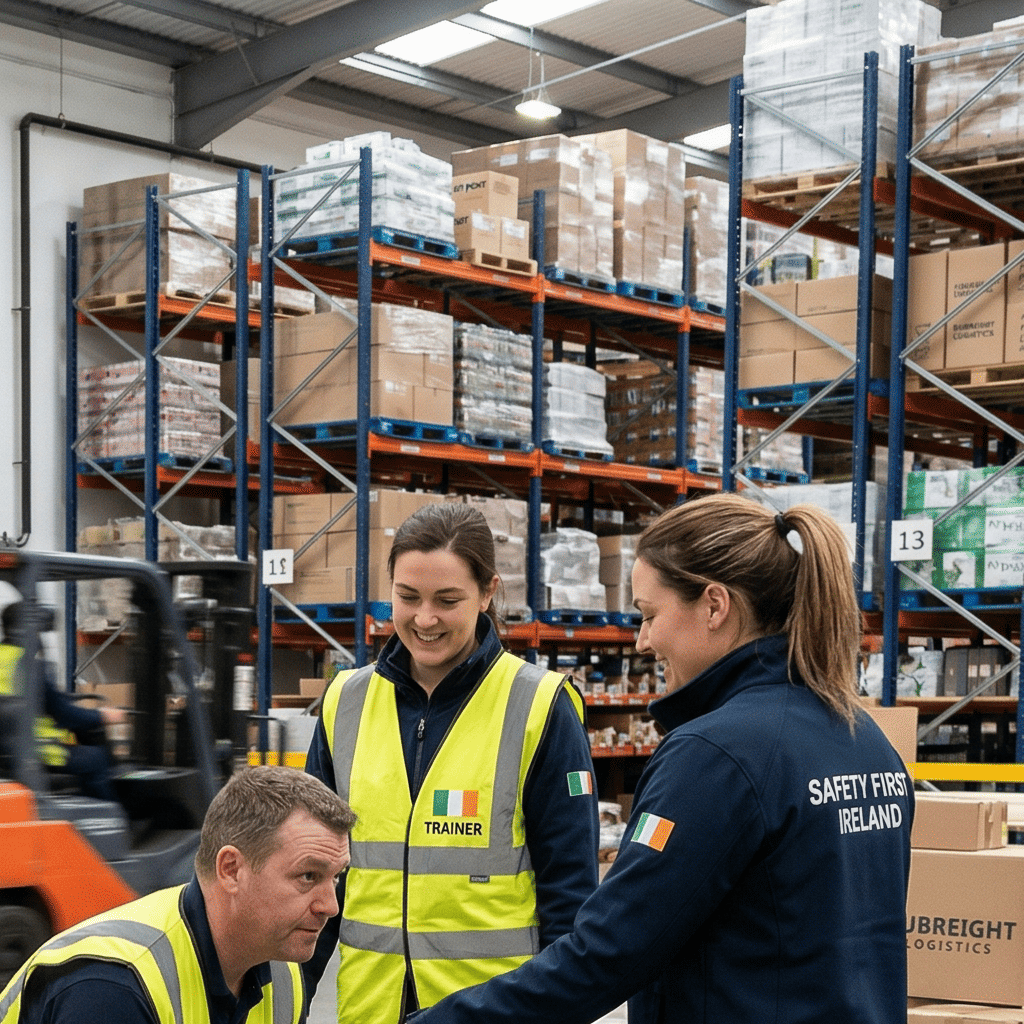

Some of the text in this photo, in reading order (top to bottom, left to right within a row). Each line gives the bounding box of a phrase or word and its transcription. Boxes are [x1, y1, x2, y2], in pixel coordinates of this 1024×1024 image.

[899, 530, 924, 550] 13
[808, 772, 908, 805] SAFETY FIRST
[424, 822, 482, 835] TRAINER
[838, 803, 902, 834] IRELAND
[906, 915, 1017, 940] UBREIGHT
